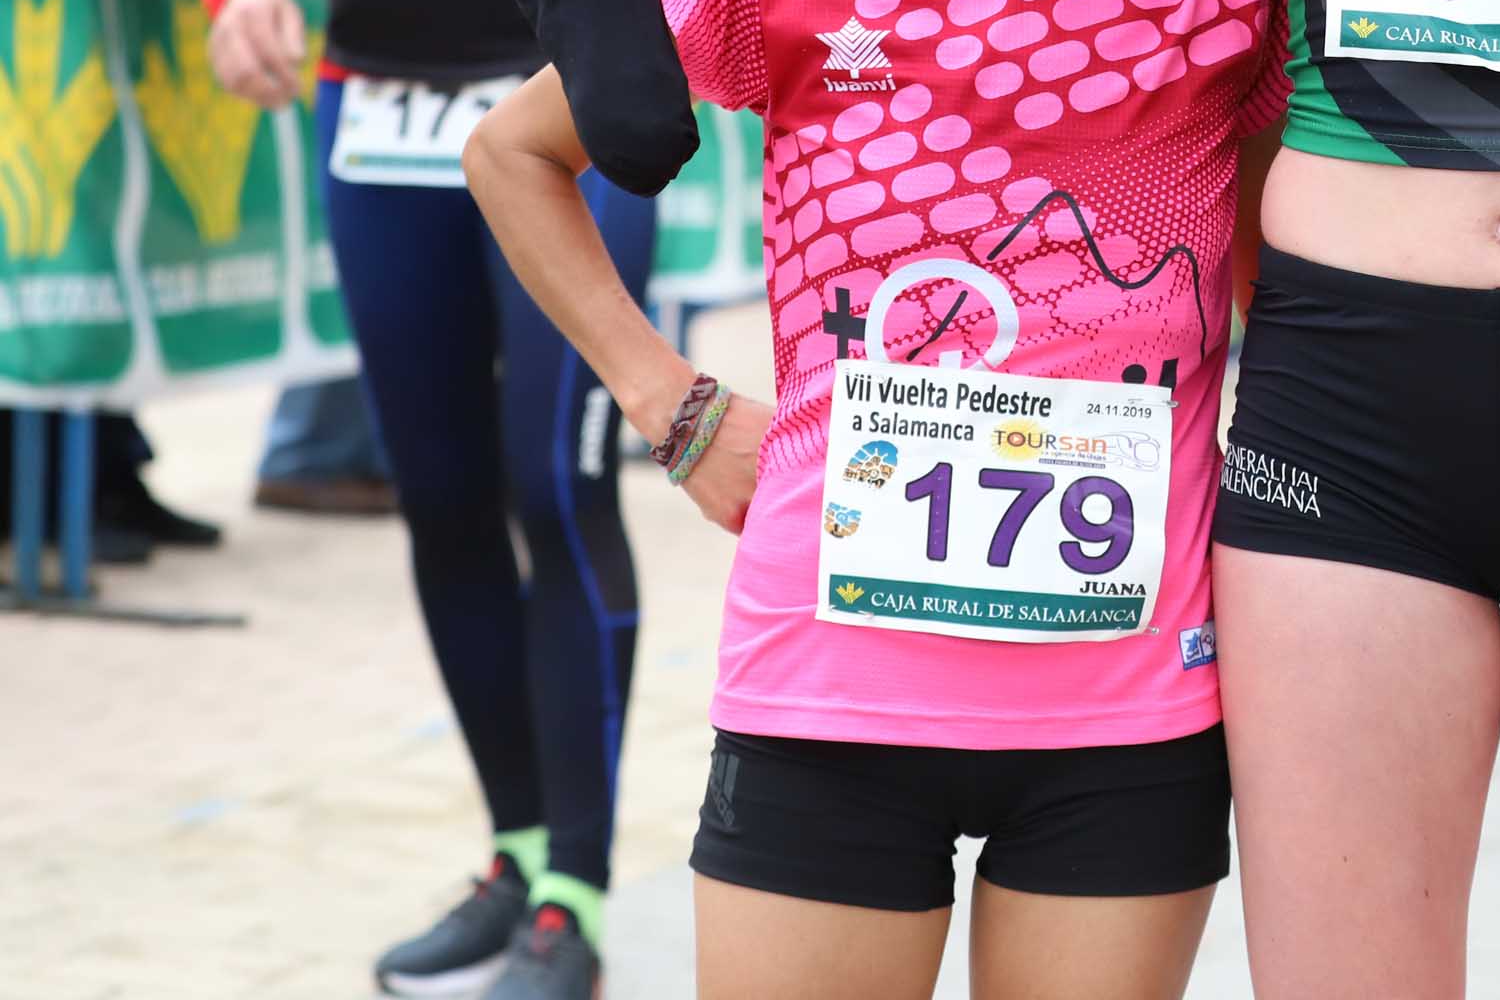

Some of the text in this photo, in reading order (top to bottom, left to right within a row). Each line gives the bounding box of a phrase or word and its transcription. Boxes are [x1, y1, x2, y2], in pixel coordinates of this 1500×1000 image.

[1385, 26, 1433, 43] CAJA
[879, 377, 948, 409] Vuelta
[955, 382, 1052, 418] Pedestre
[1086, 402, 1153, 419] 24.11.2019
[853, 411, 974, 442] a Salamanca
[905, 462, 1134, 575] 179
[1079, 580, 1147, 596] JUANA
[871, 592, 1138, 623] CAJA RURAL DE SALAMANCA
